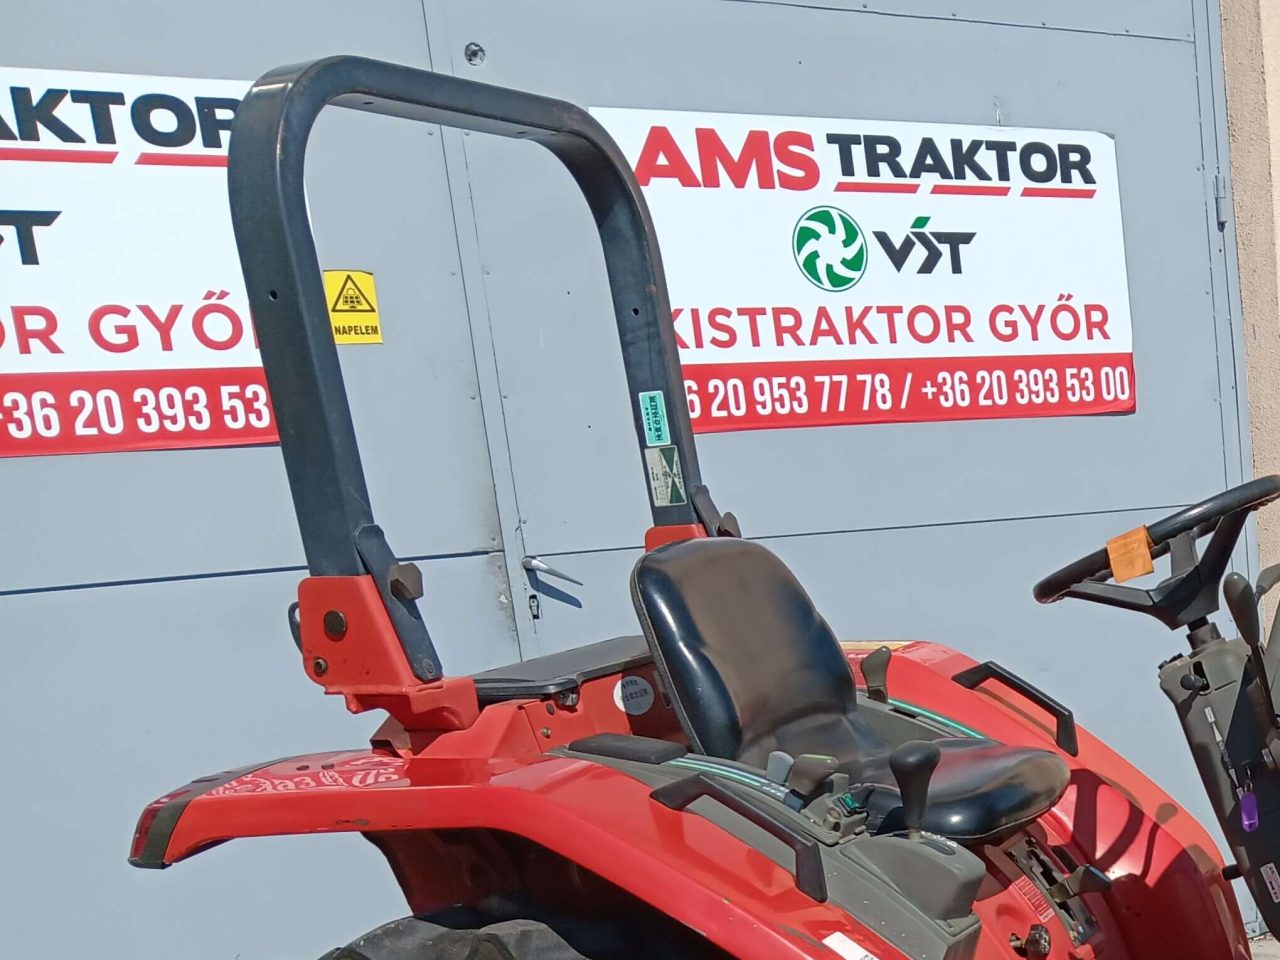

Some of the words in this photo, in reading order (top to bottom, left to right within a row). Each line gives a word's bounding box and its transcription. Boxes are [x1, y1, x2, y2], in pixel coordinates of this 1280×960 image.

[634, 126, 820, 191] AMS
[826, 133, 1096, 184] TRAKTOR
[88, 289, 260, 353] GYŐ
[334, 325, 379, 335] NAPELEM
[988, 293, 1111, 342] GYŐR
[69, 388, 124, 436] 20
[132, 386, 211, 433] 393
[220, 383, 271, 429] 53
[707, 377, 747, 417] 20
[752, 376, 808, 415] 953
[814, 374, 848, 413] 77
[856, 373, 893, 411] 78
[921, 370, 971, 408] +36
[975, 369, 1008, 406] 20
[1013, 368, 1060, 405] 393
[1065, 366, 1096, 403] 53
[1100, 365, 1130, 401] 00
